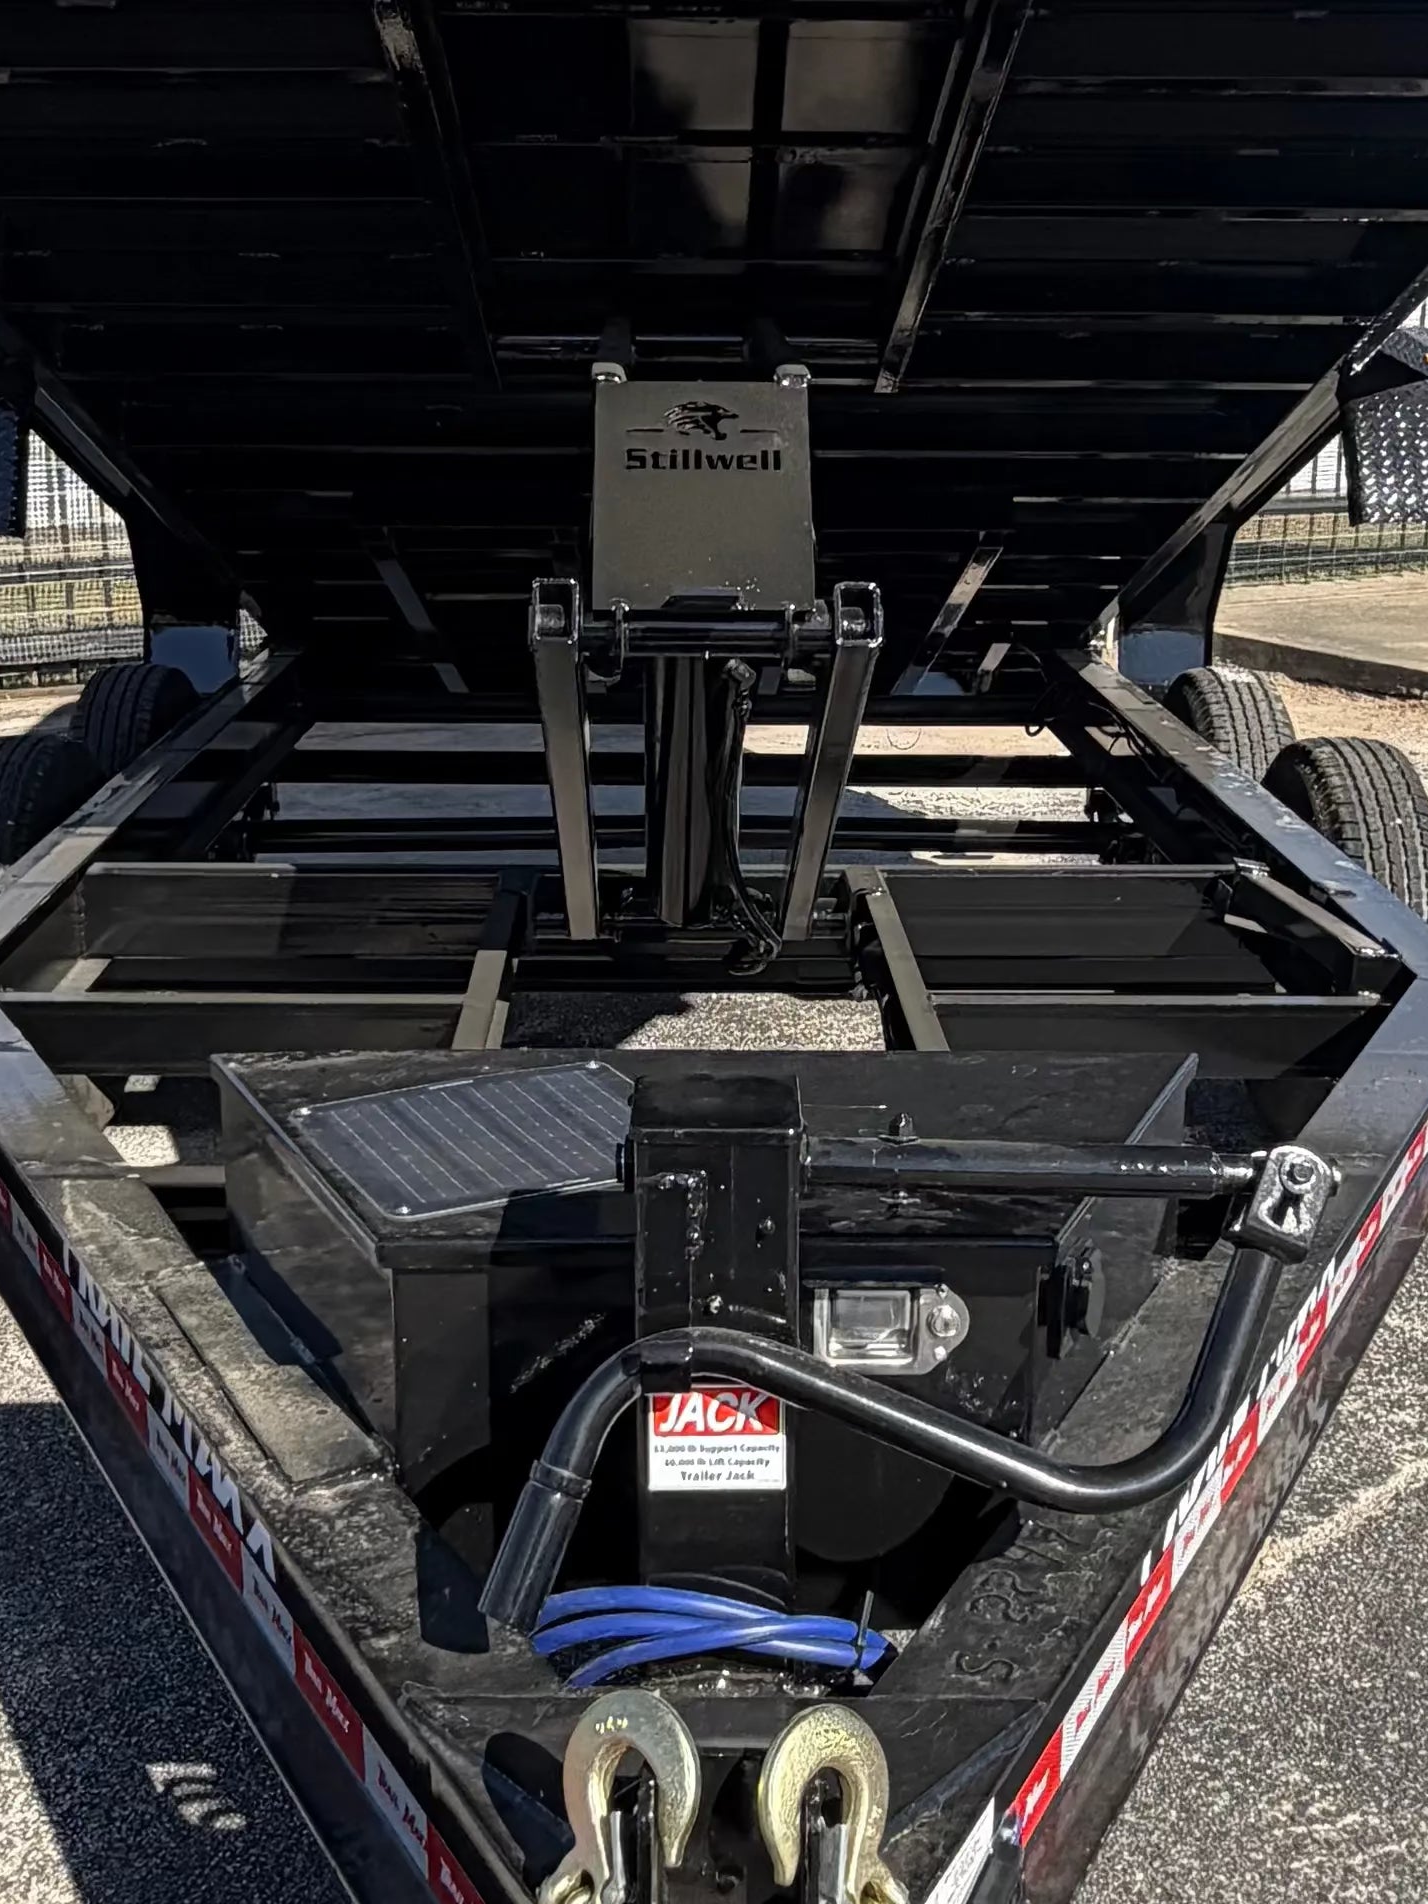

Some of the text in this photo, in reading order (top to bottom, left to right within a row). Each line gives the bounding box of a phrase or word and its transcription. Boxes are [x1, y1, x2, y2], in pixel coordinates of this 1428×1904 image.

[625, 448, 781, 471] Stillwell
[659, 1391, 770, 1432] JACK
[699, 1443, 737, 1455] Support
[740, 1443, 780, 1454] Capacity
[680, 1470, 722, 1481] Trailer
[725, 1470, 755, 1481] Jack
